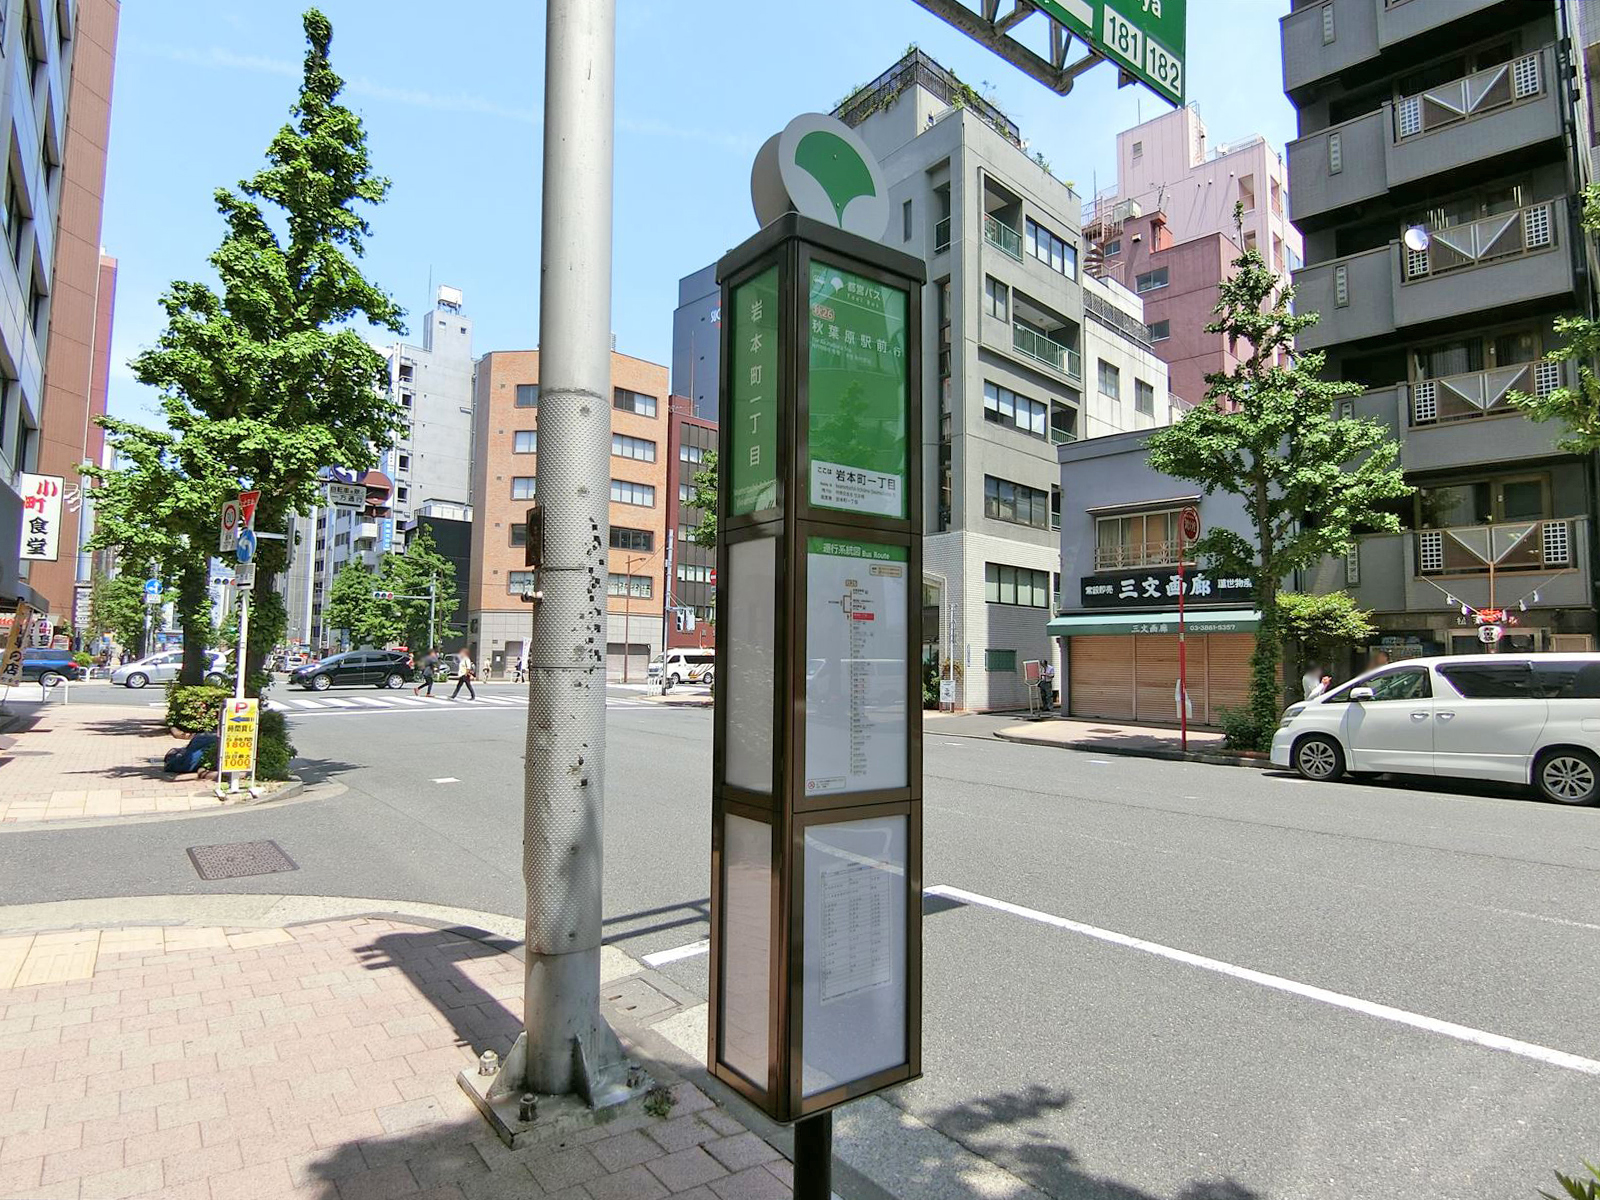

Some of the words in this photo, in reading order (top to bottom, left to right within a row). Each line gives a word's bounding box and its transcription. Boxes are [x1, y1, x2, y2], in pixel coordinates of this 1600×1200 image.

[1109, 16, 1138, 61] 181
[1149, 47, 1179, 91] 182
[749, 299, 763, 467] 岩本町一丁目
[817, 466, 832, 475] ここは
[835, 469, 896, 491] 岩本町一丁目
[24, 479, 58, 556] 小町食堂
[862, 549, 873, 558] Bus
[873, 551, 890, 560] Route
[1118, 573, 1212, 599] 三文画廊
[235, 702, 248, 713] P
[224, 759, 251, 767] 1000
